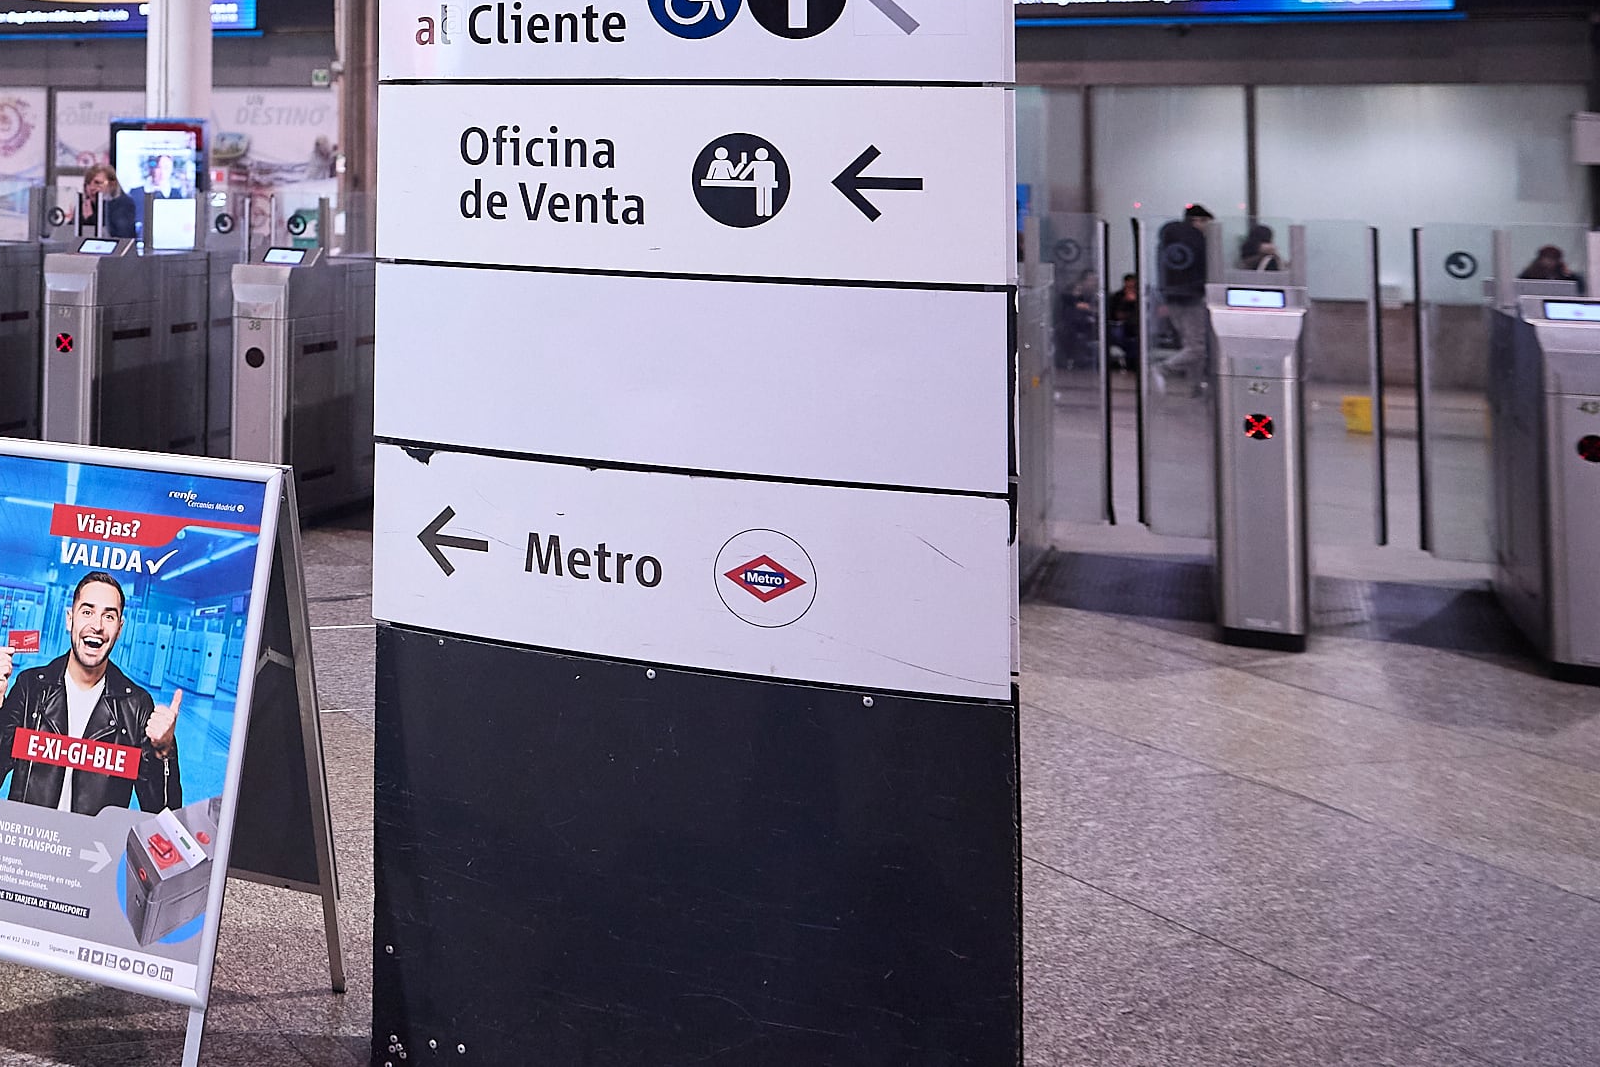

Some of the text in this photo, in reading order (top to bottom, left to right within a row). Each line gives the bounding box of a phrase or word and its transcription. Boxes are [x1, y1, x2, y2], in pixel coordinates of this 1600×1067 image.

[468, 1, 628, 46] Cliente
[460, 125, 615, 169] Oficina
[460, 178, 645, 225] de Venta
[169, 489, 198, 504] renfe
[187, 499, 237, 512] Cercanías Madrid
[76, 513, 141, 539] Viajas?
[61, 541, 142, 574] VALIDA
[524, 532, 663, 588] Metro
[745, 570, 783, 586] Metro
[27, 734, 127, 773] E-XI-GI-BLE
[5, 834, 17, 846] DE
[18, 836, 72, 858] TRANSPORTE
[23, 825, 34, 836] TU
[36, 828, 61, 844] VIAJE,
[5, 891, 14, 900] TU
[14, 893, 38, 906] TARJETA
[39, 898, 47, 908] DE
[48, 900, 88, 917] TRANSPORTE
